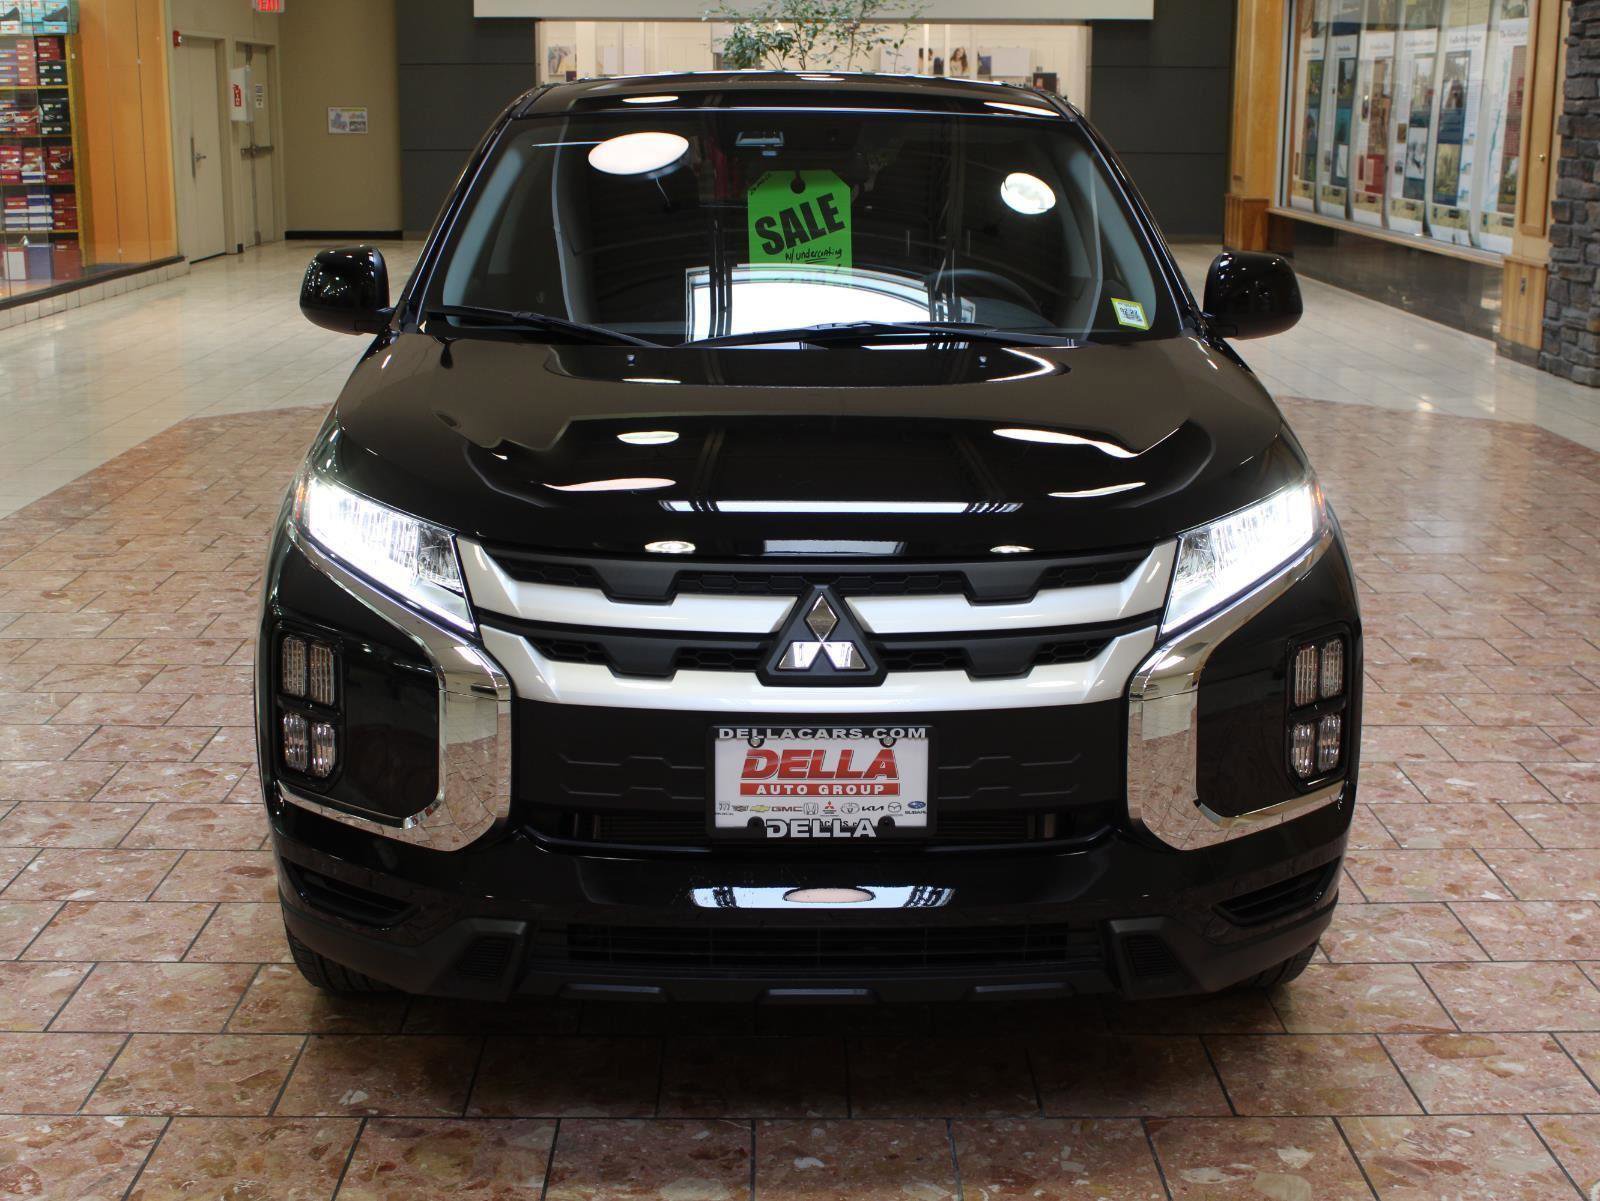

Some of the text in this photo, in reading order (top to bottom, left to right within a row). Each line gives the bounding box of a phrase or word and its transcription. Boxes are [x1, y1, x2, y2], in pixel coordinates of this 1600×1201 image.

[755, 193, 846, 255] SALE
[719, 728, 926, 739] DELLACARS.COM
[741, 749, 900, 780] DELLA
[756, 785, 885, 795] AUTO GROUP
[766, 819, 877, 838] DELLA
